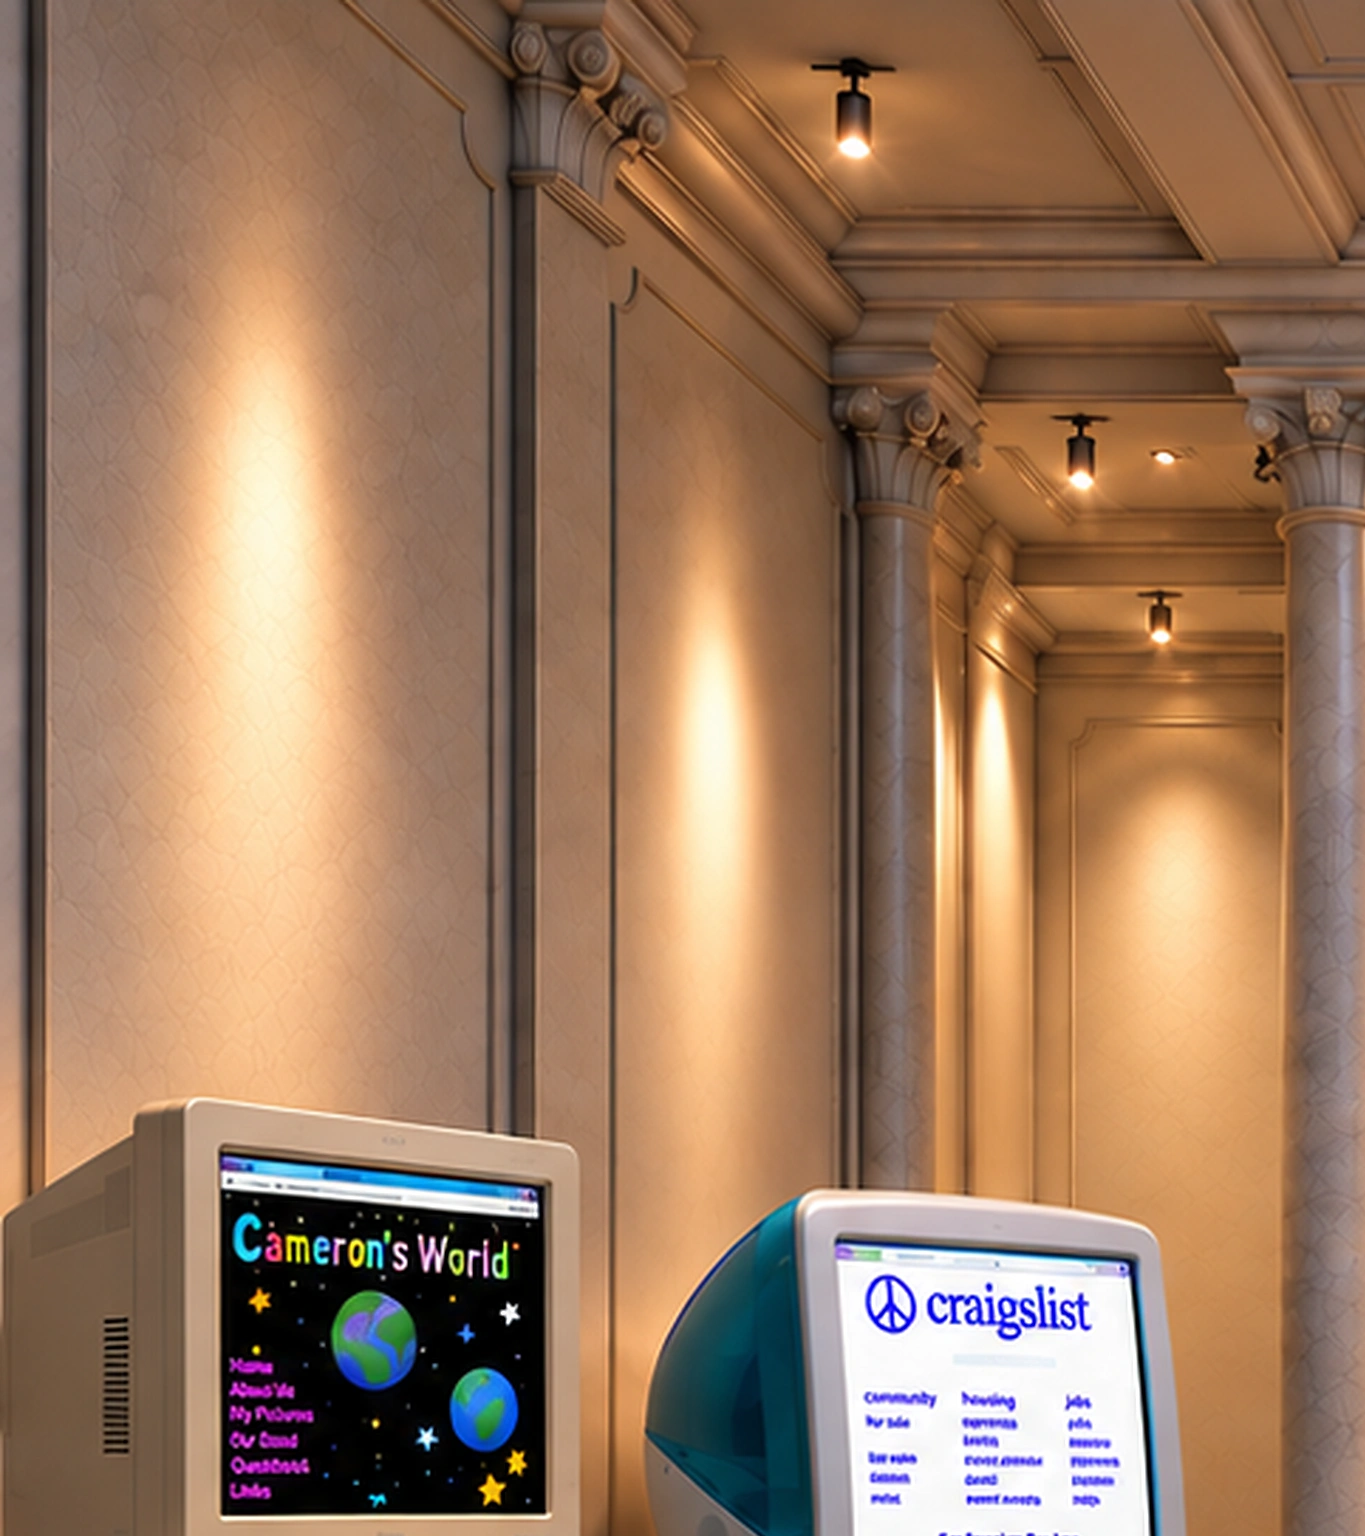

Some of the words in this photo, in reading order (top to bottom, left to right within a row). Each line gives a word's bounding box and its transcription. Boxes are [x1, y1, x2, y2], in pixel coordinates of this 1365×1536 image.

[232, 1212, 409, 1272] Cameron's
[417, 1233, 509, 1280] World
[926, 1282, 1092, 1341] craigslist
